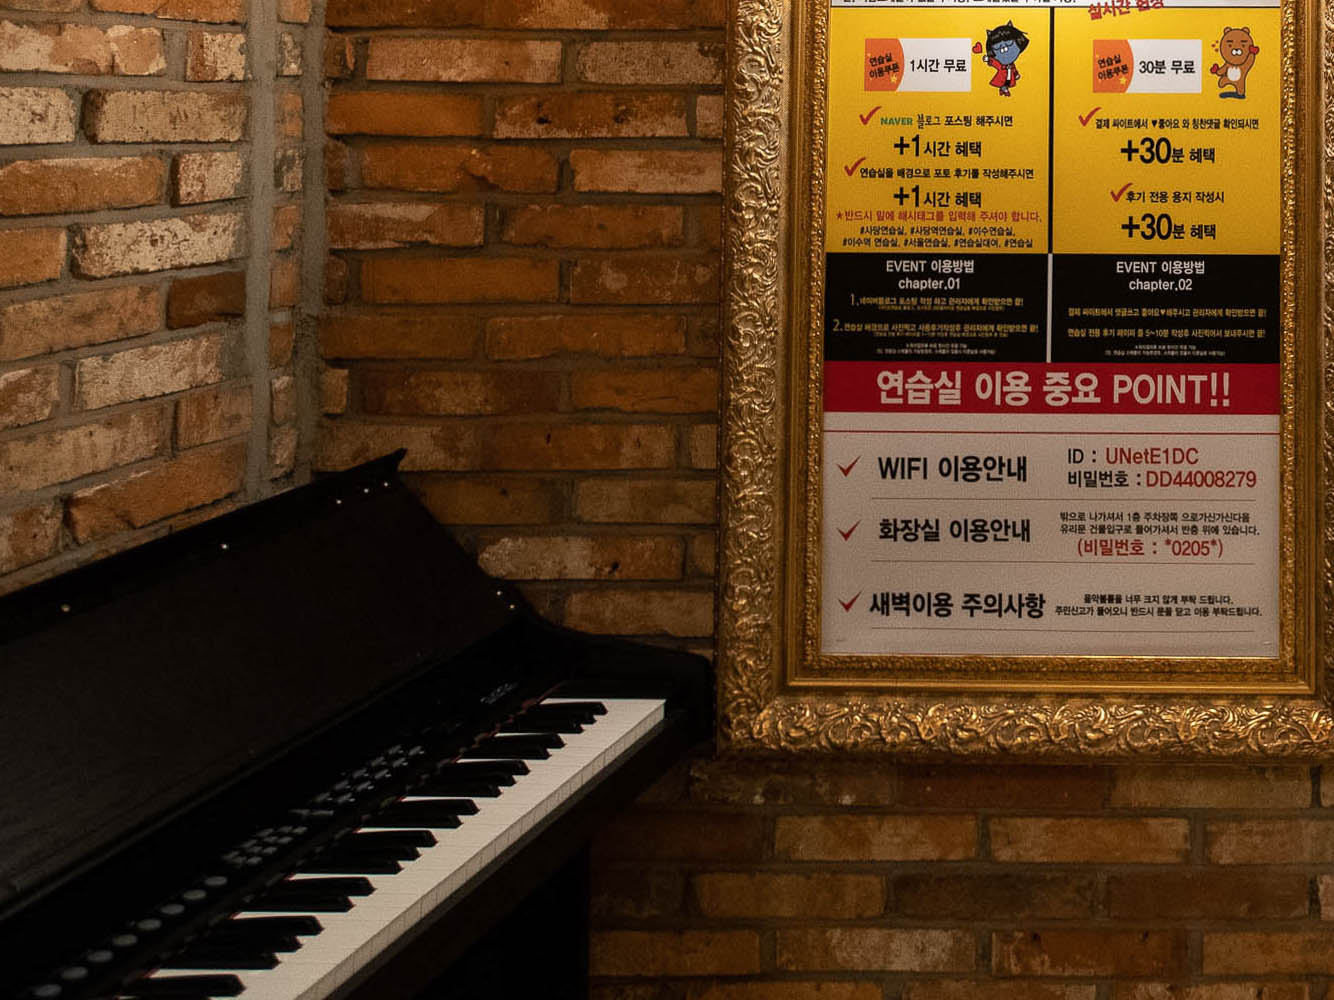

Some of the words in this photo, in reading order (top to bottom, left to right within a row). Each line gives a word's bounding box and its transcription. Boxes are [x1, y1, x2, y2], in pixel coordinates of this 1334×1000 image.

[910, 59, 939, 73] 1시간
[944, 59, 967, 72] 무료
[1139, 61, 1165, 74] 30분
[1171, 61, 1195, 73] 무료
[880, 117, 912, 125] NAVER
[976, 115, 1013, 126] 해주시면
[955, 141, 982, 157] 혜택
[1190, 148, 1215, 163] 혜택
[955, 192, 982, 208] 혜택
[1126, 191, 1145, 203] 후기
[1150, 192, 1168, 203] 전용
[1173, 192, 1191, 203] 용지
[1196, 192, 1224, 203] 작성시
[1191, 224, 1216, 239] 혜택
[886, 260, 926, 272] EVENT
[931, 260, 974, 273] 이용방법
[1117, 261, 1156, 273] EVENT
[1162, 261, 1205, 274] 이용방법
[899, 277, 960, 290] chapter.01
[1129, 278, 1192, 291] chapter.02
[877, 371, 961, 405] 연습실
[975, 371, 1032, 406] 이용
[1043, 372, 1101, 406] 중요
[1113, 373, 1230, 407] POINT!!
[1068, 449, 1083, 464] ID
[1106, 448, 1199, 464] UNetE1DC
[879, 457, 927, 479] WIFI
[939, 456, 1026, 482] 이용안내
[1068, 471, 1128, 487] 비밀번호
[1146, 471, 1256, 487] DD44008279
[879, 519, 939, 542] 화장실
[950, 519, 1030, 542] 이용안내
[1078, 539, 1144, 556] (비밀번호
[870, 592, 953, 617] 새벽이용
[962, 593, 1045, 618] 주의사항
